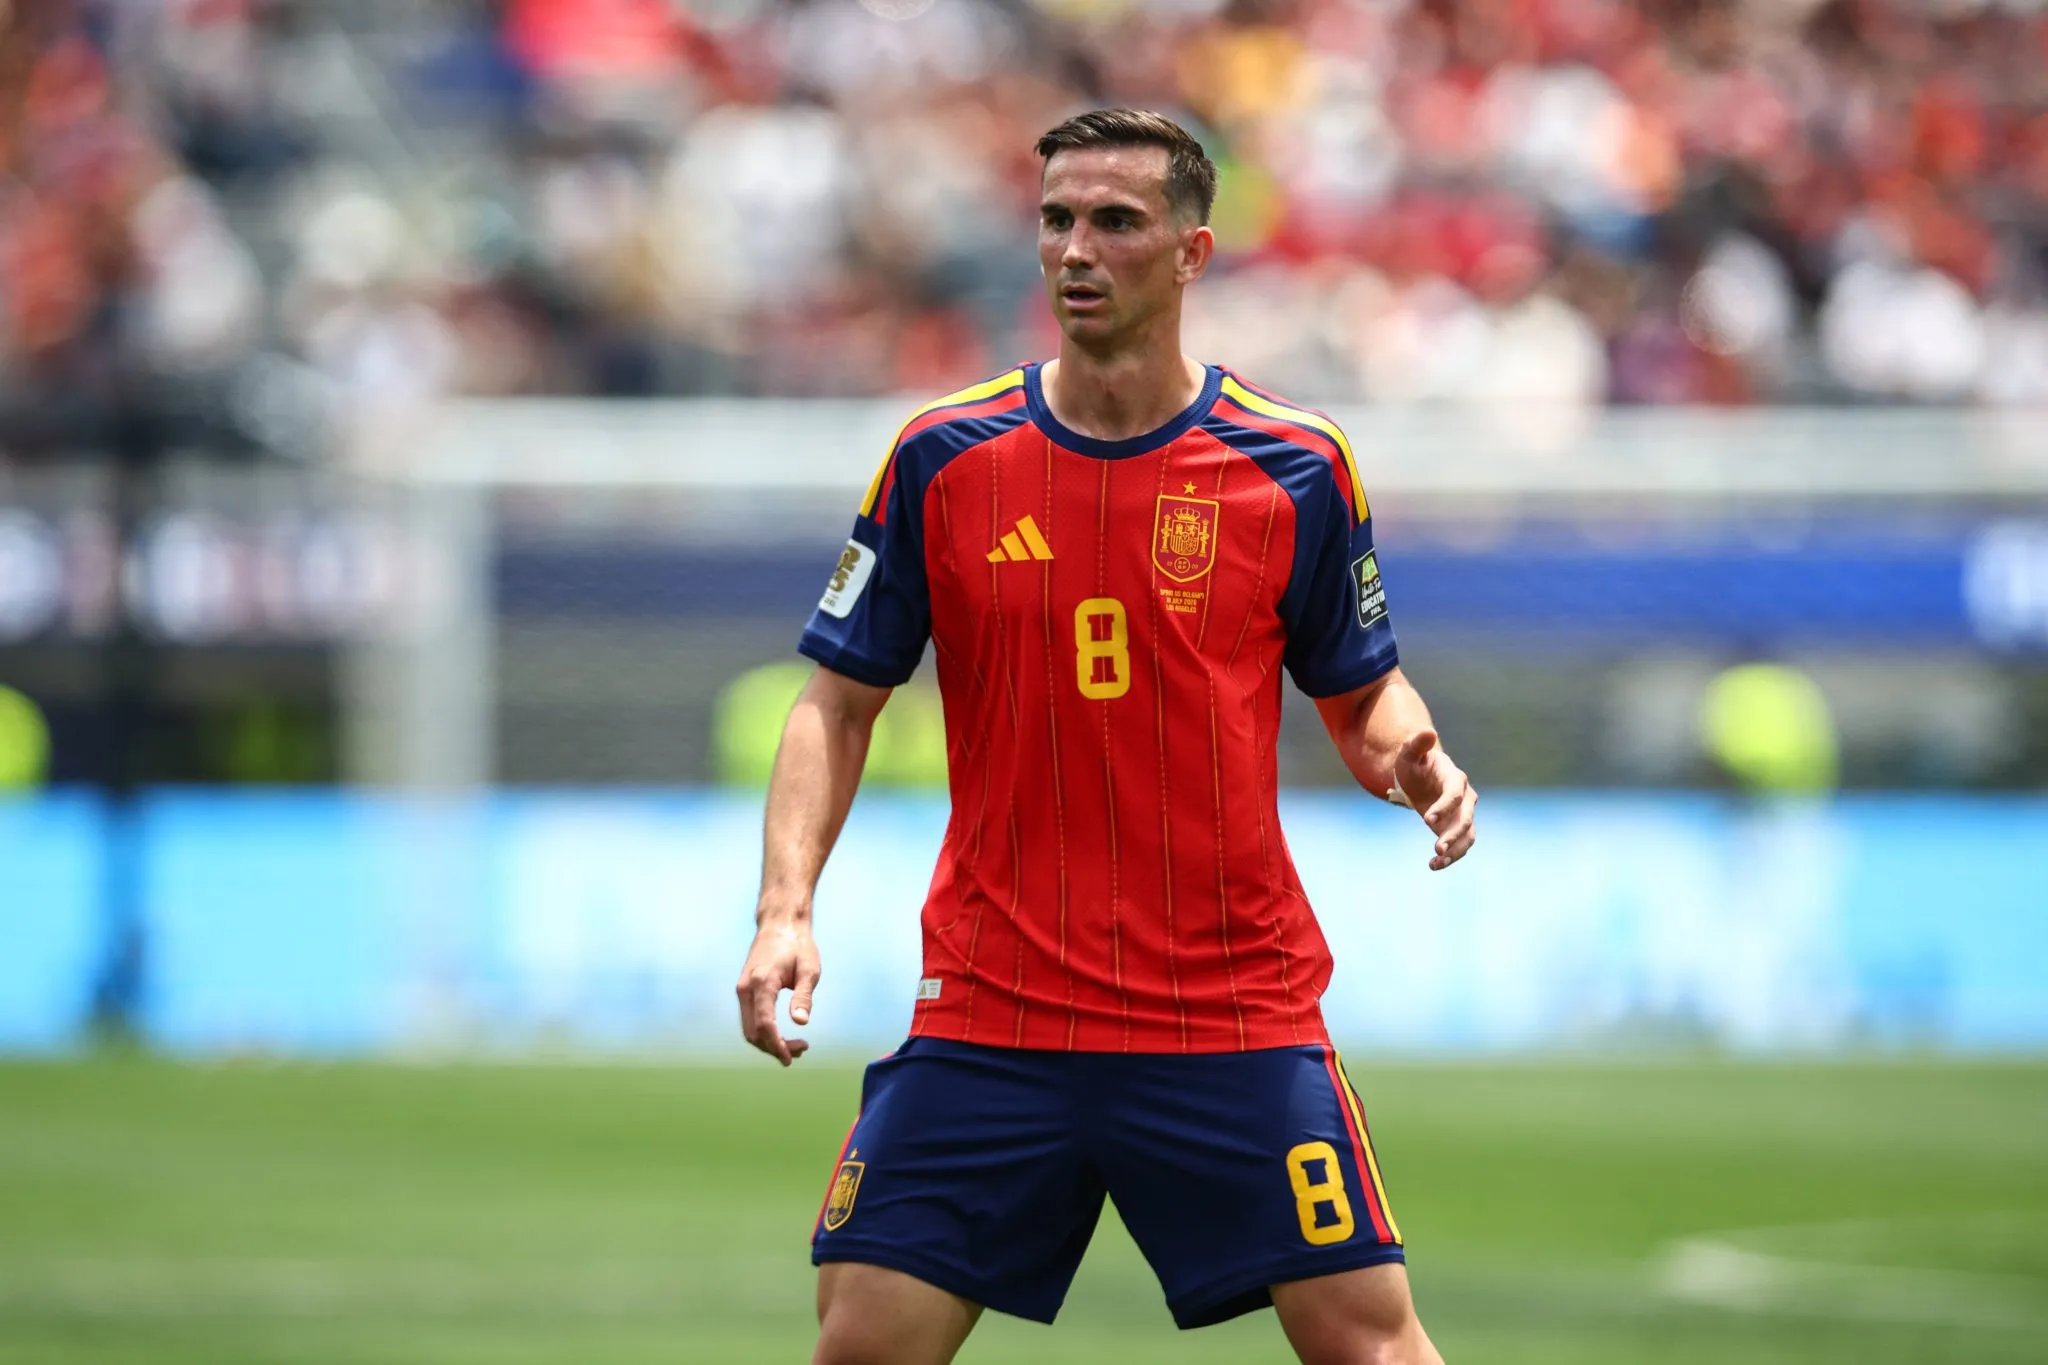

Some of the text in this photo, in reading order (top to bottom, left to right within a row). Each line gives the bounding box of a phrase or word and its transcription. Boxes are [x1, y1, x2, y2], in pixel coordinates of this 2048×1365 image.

[1074, 597, 1130, 700] 8
[1370, 605, 1382, 616] FIFA
[1286, 1141, 1355, 1246] 8
